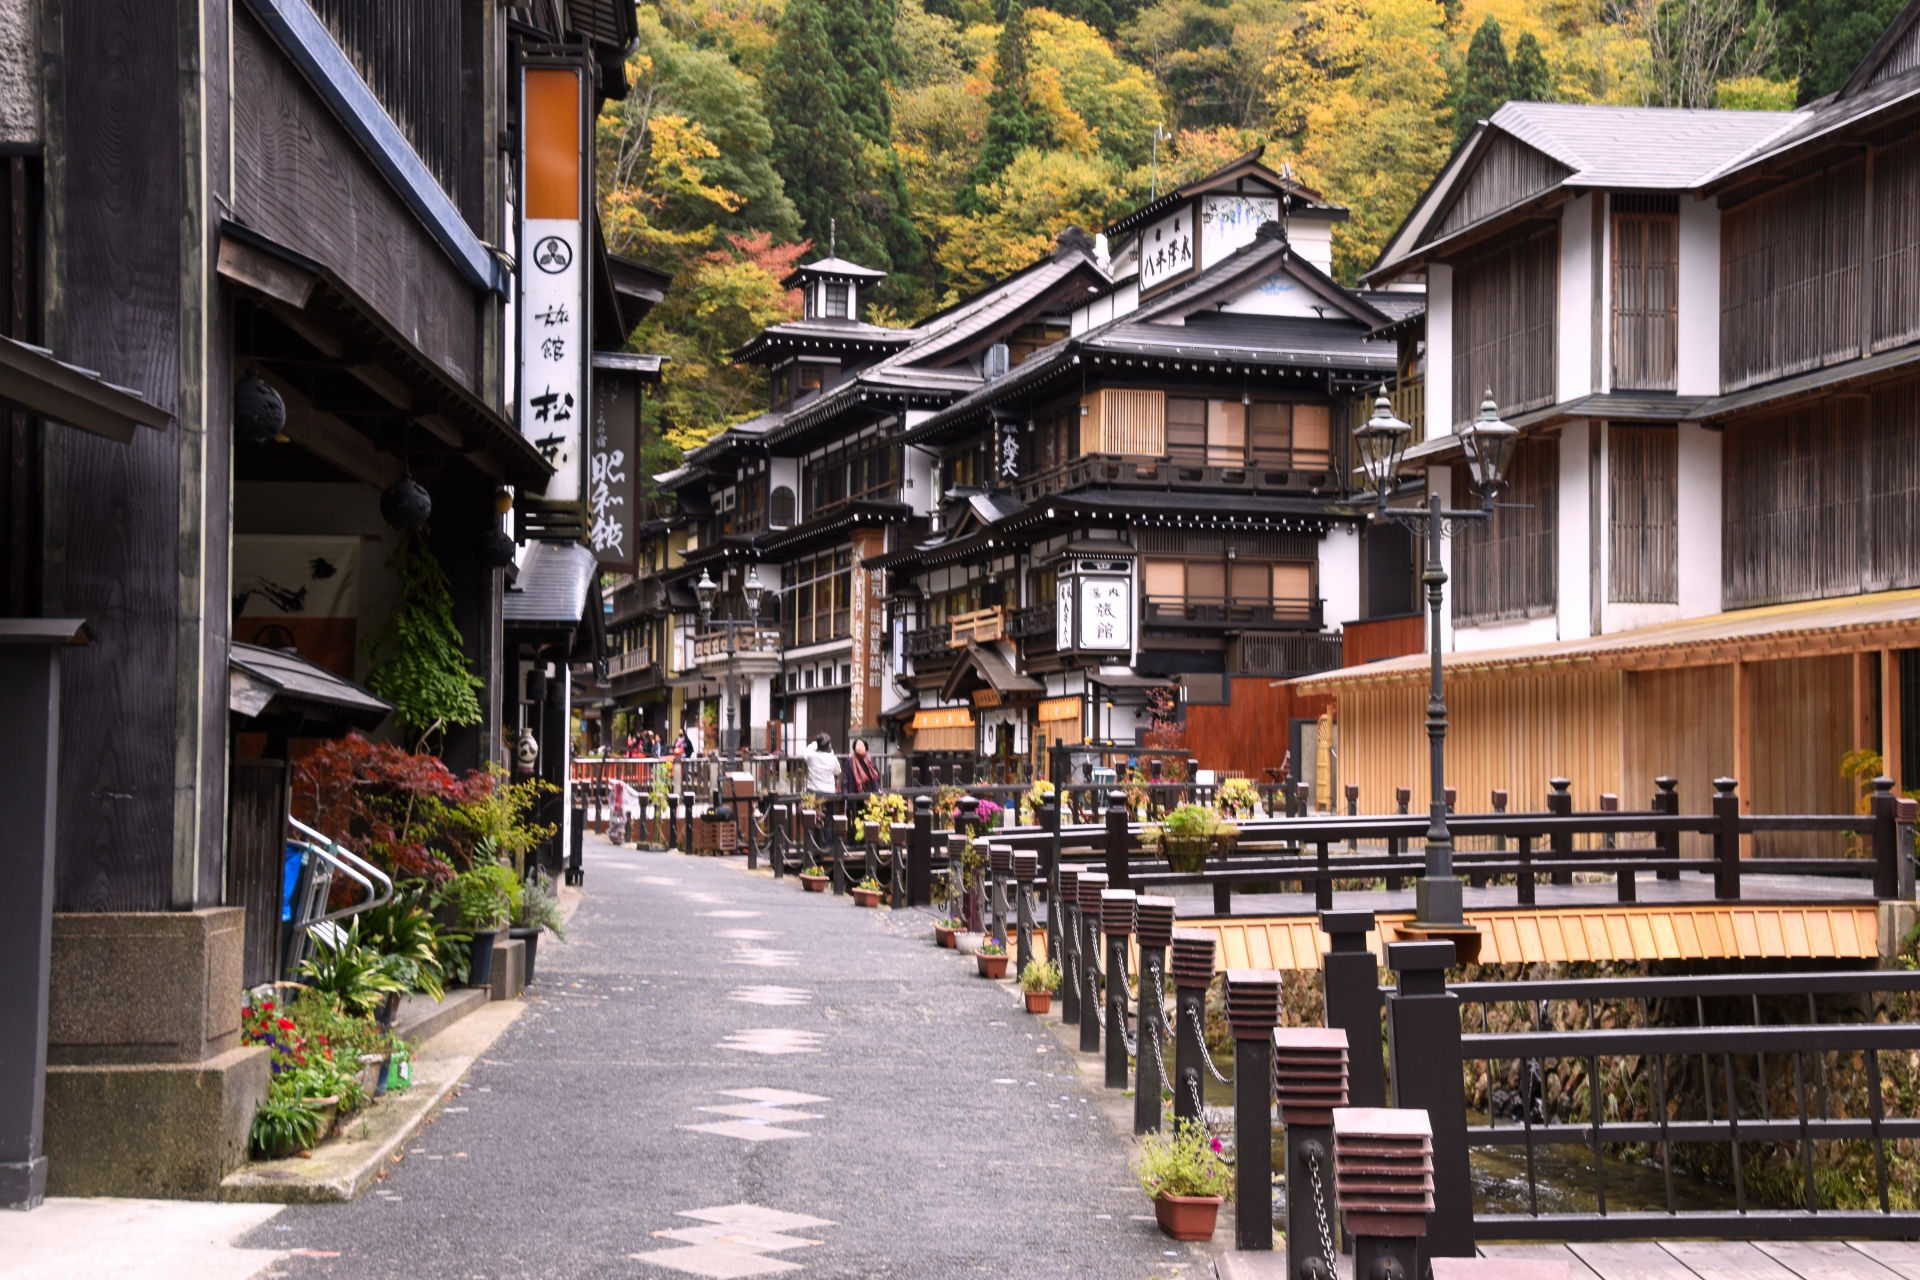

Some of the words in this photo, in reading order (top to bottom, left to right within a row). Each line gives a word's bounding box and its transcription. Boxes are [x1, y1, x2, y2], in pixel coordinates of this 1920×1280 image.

[534, 303, 570, 362] 旅館
[529, 383, 575, 466] 松本
[1095, 602, 1117, 640] 旅館
